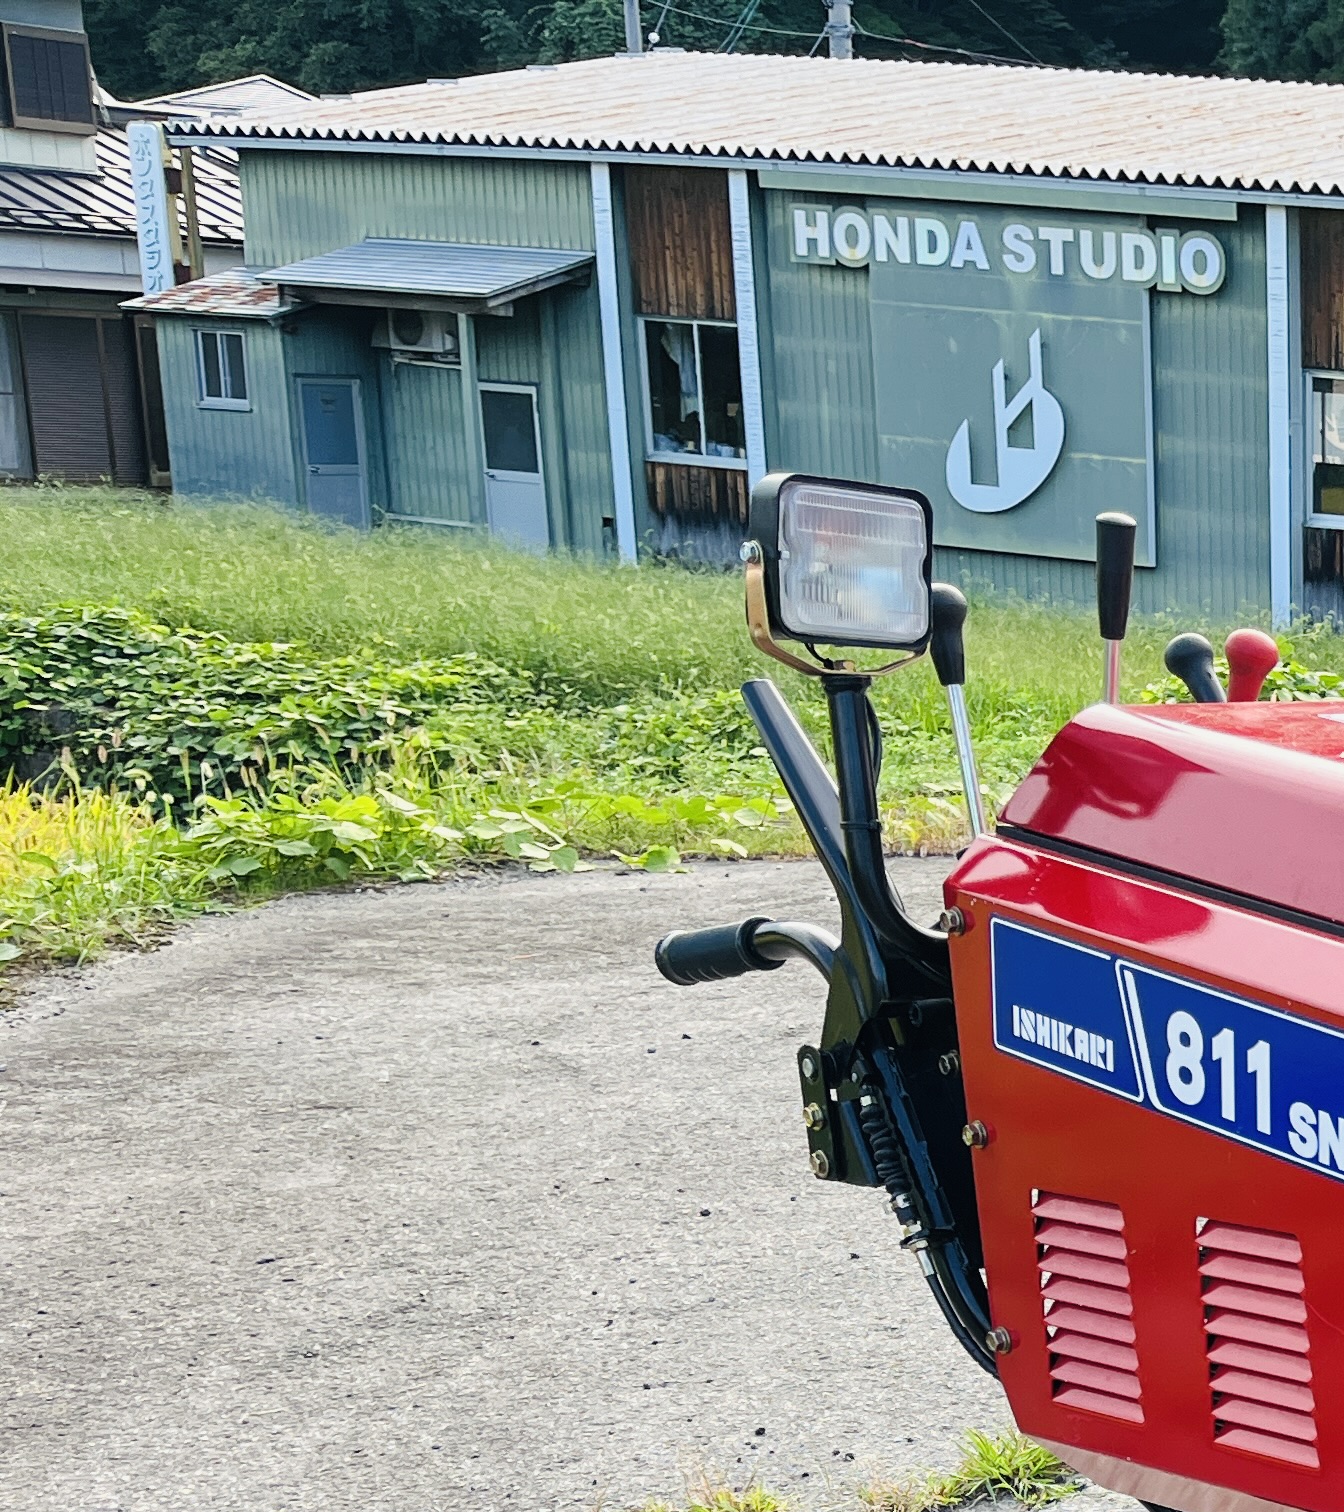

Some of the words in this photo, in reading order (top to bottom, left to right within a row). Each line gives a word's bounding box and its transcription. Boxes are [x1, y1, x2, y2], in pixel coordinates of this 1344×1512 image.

[792, 209, 990, 270] HONDA
[1001, 224, 1222, 289] STUDIO
[1011, 1004, 1114, 1072] ISHIKARI
[1165, 1010, 1271, 1135] 811
